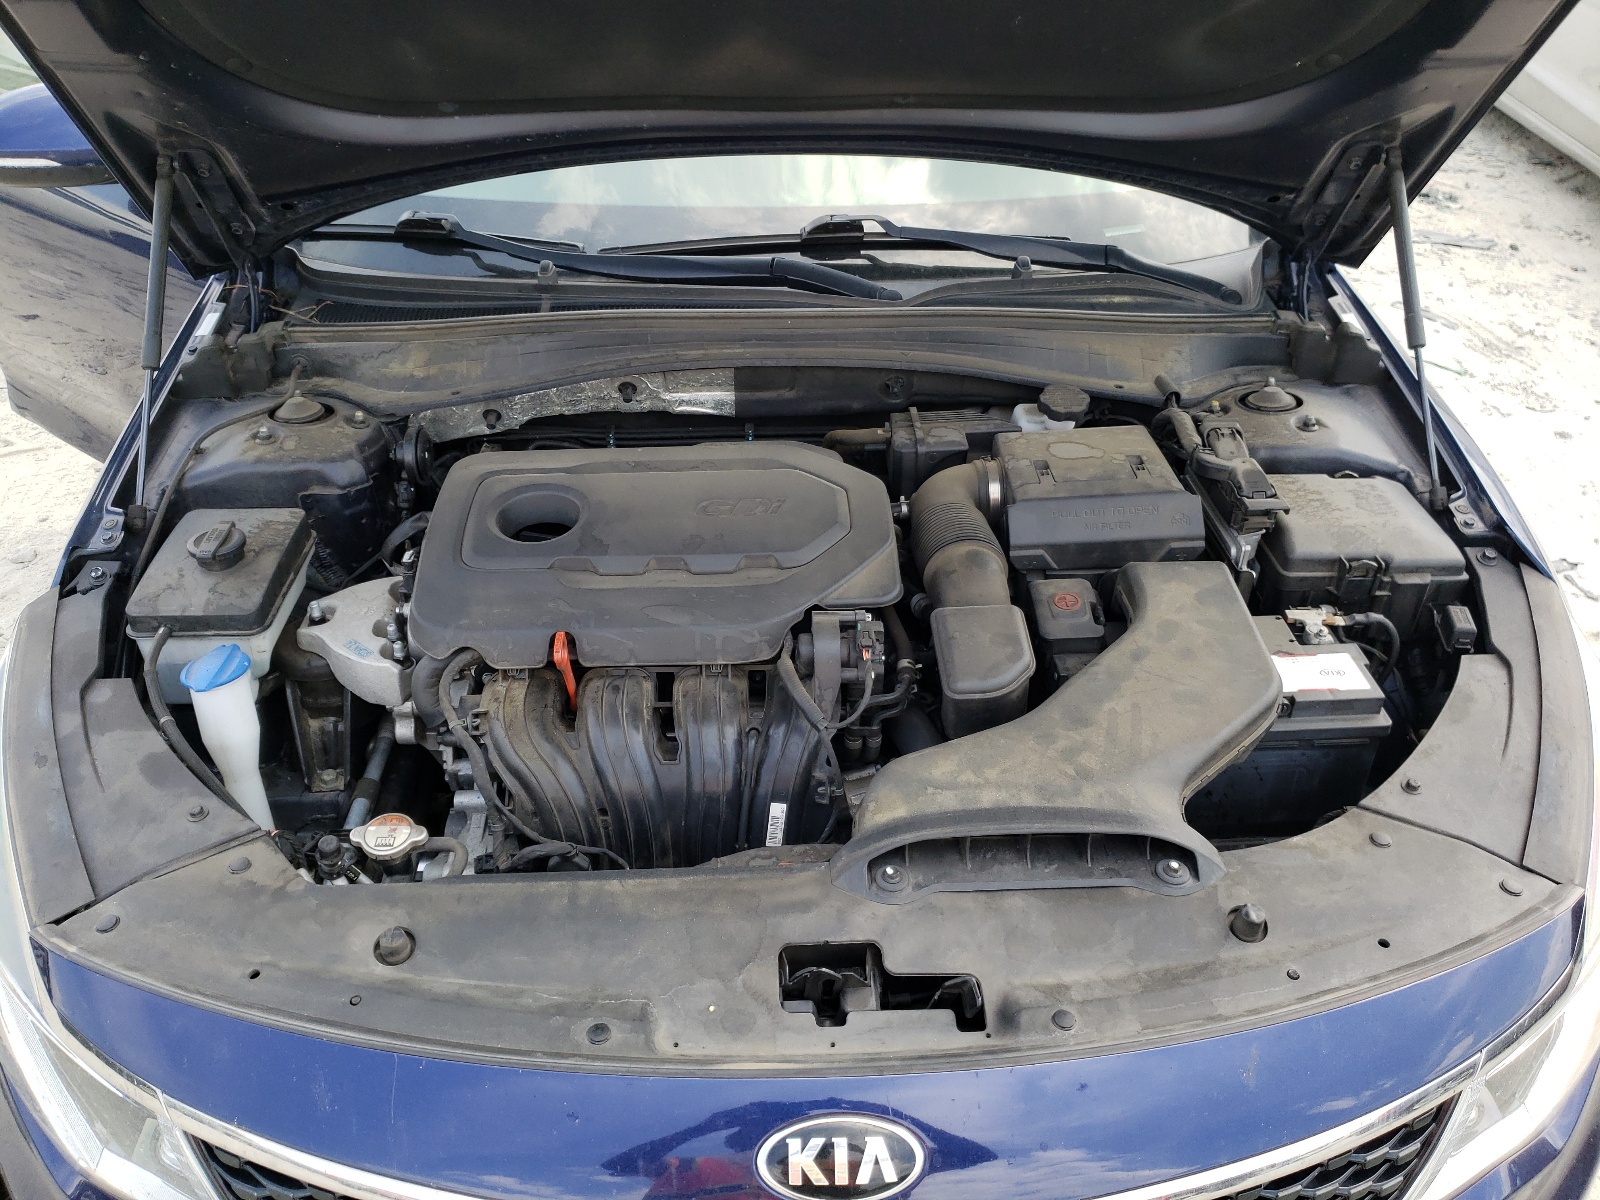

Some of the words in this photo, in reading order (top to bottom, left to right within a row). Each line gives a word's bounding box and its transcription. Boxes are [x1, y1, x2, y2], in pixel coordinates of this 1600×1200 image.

[1052, 510, 1080, 519] PULL
[1083, 508, 1106, 518] OUT
[1110, 507, 1125, 516] TO
[1128, 505, 1159, 516] OPEN
[1100, 521, 1131, 531] FILTER
[785, 1136, 898, 1186] KIA
